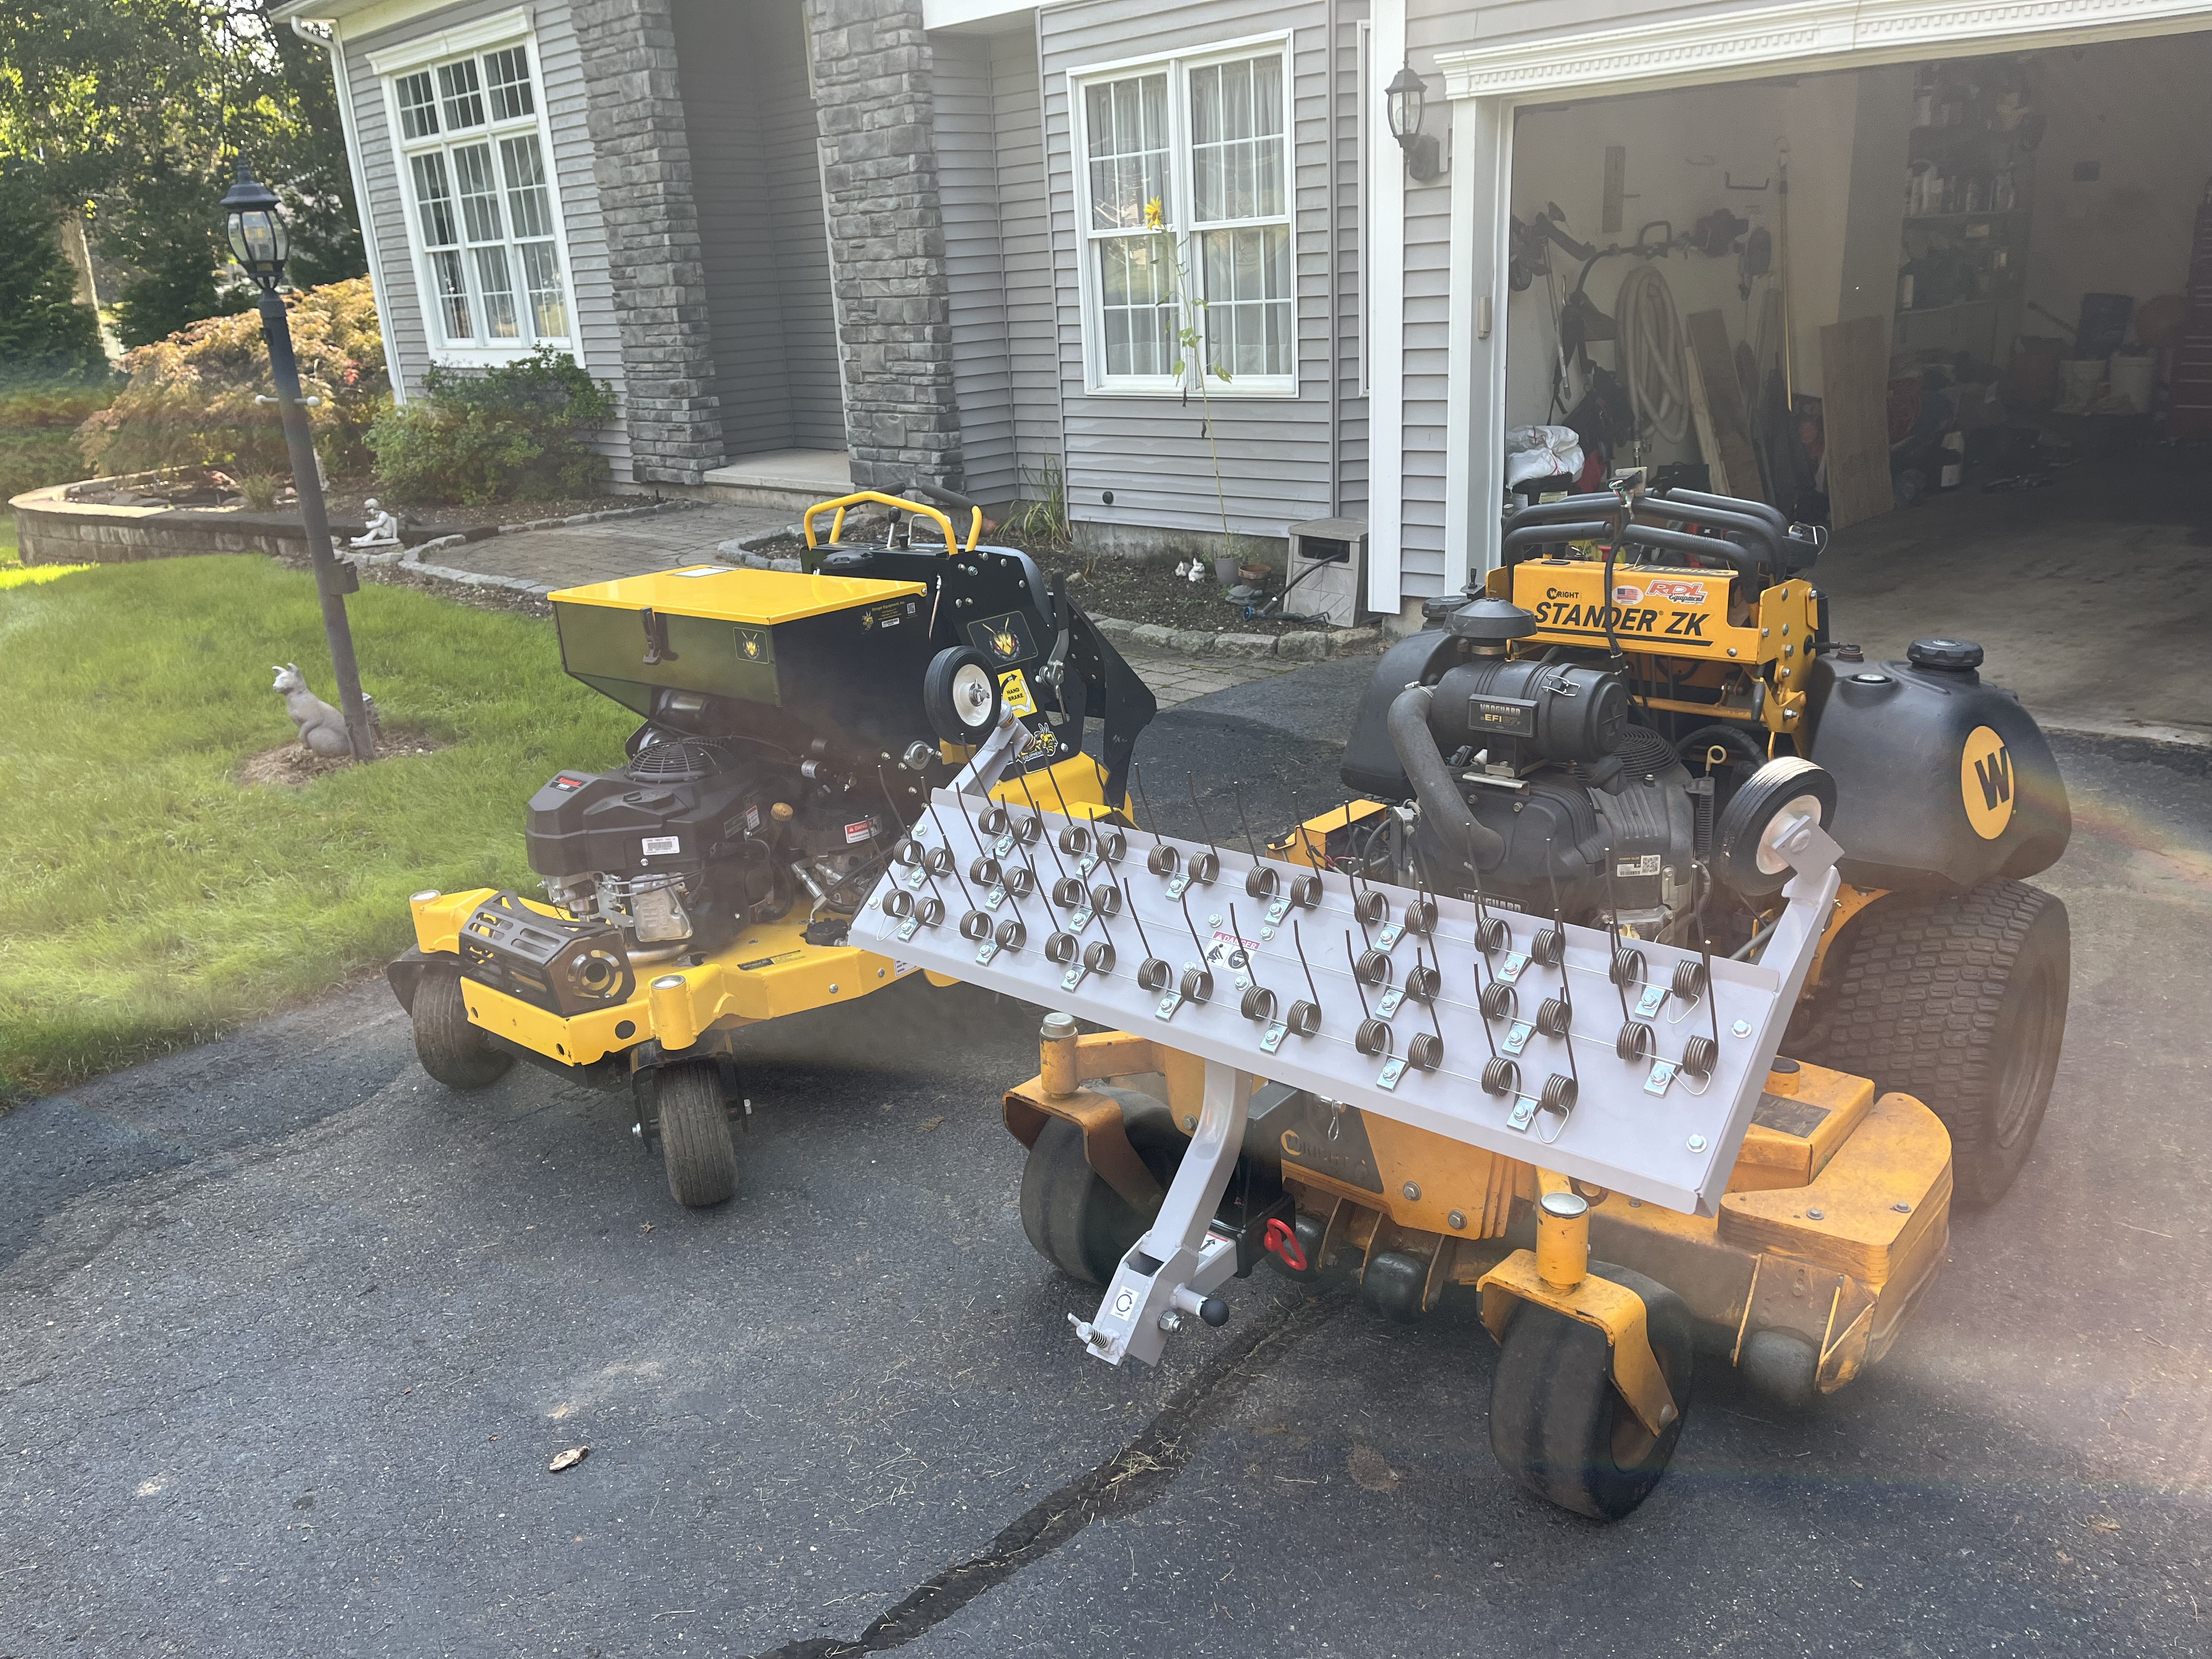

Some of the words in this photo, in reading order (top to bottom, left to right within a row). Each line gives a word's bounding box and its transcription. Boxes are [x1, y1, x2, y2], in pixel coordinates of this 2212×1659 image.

[1547, 588, 1579, 600] WRIGHT
[1647, 581, 1706, 597] RDL
[1669, 594, 1705, 603] Equipment
[1664, 611, 1710, 636] ZK
[1008, 693, 1024, 702] BRAKE
[1480, 703, 1521, 715] VANGUARD
[1974, 746, 2010, 811] W
[1224, 935, 1257, 949] DANGER
